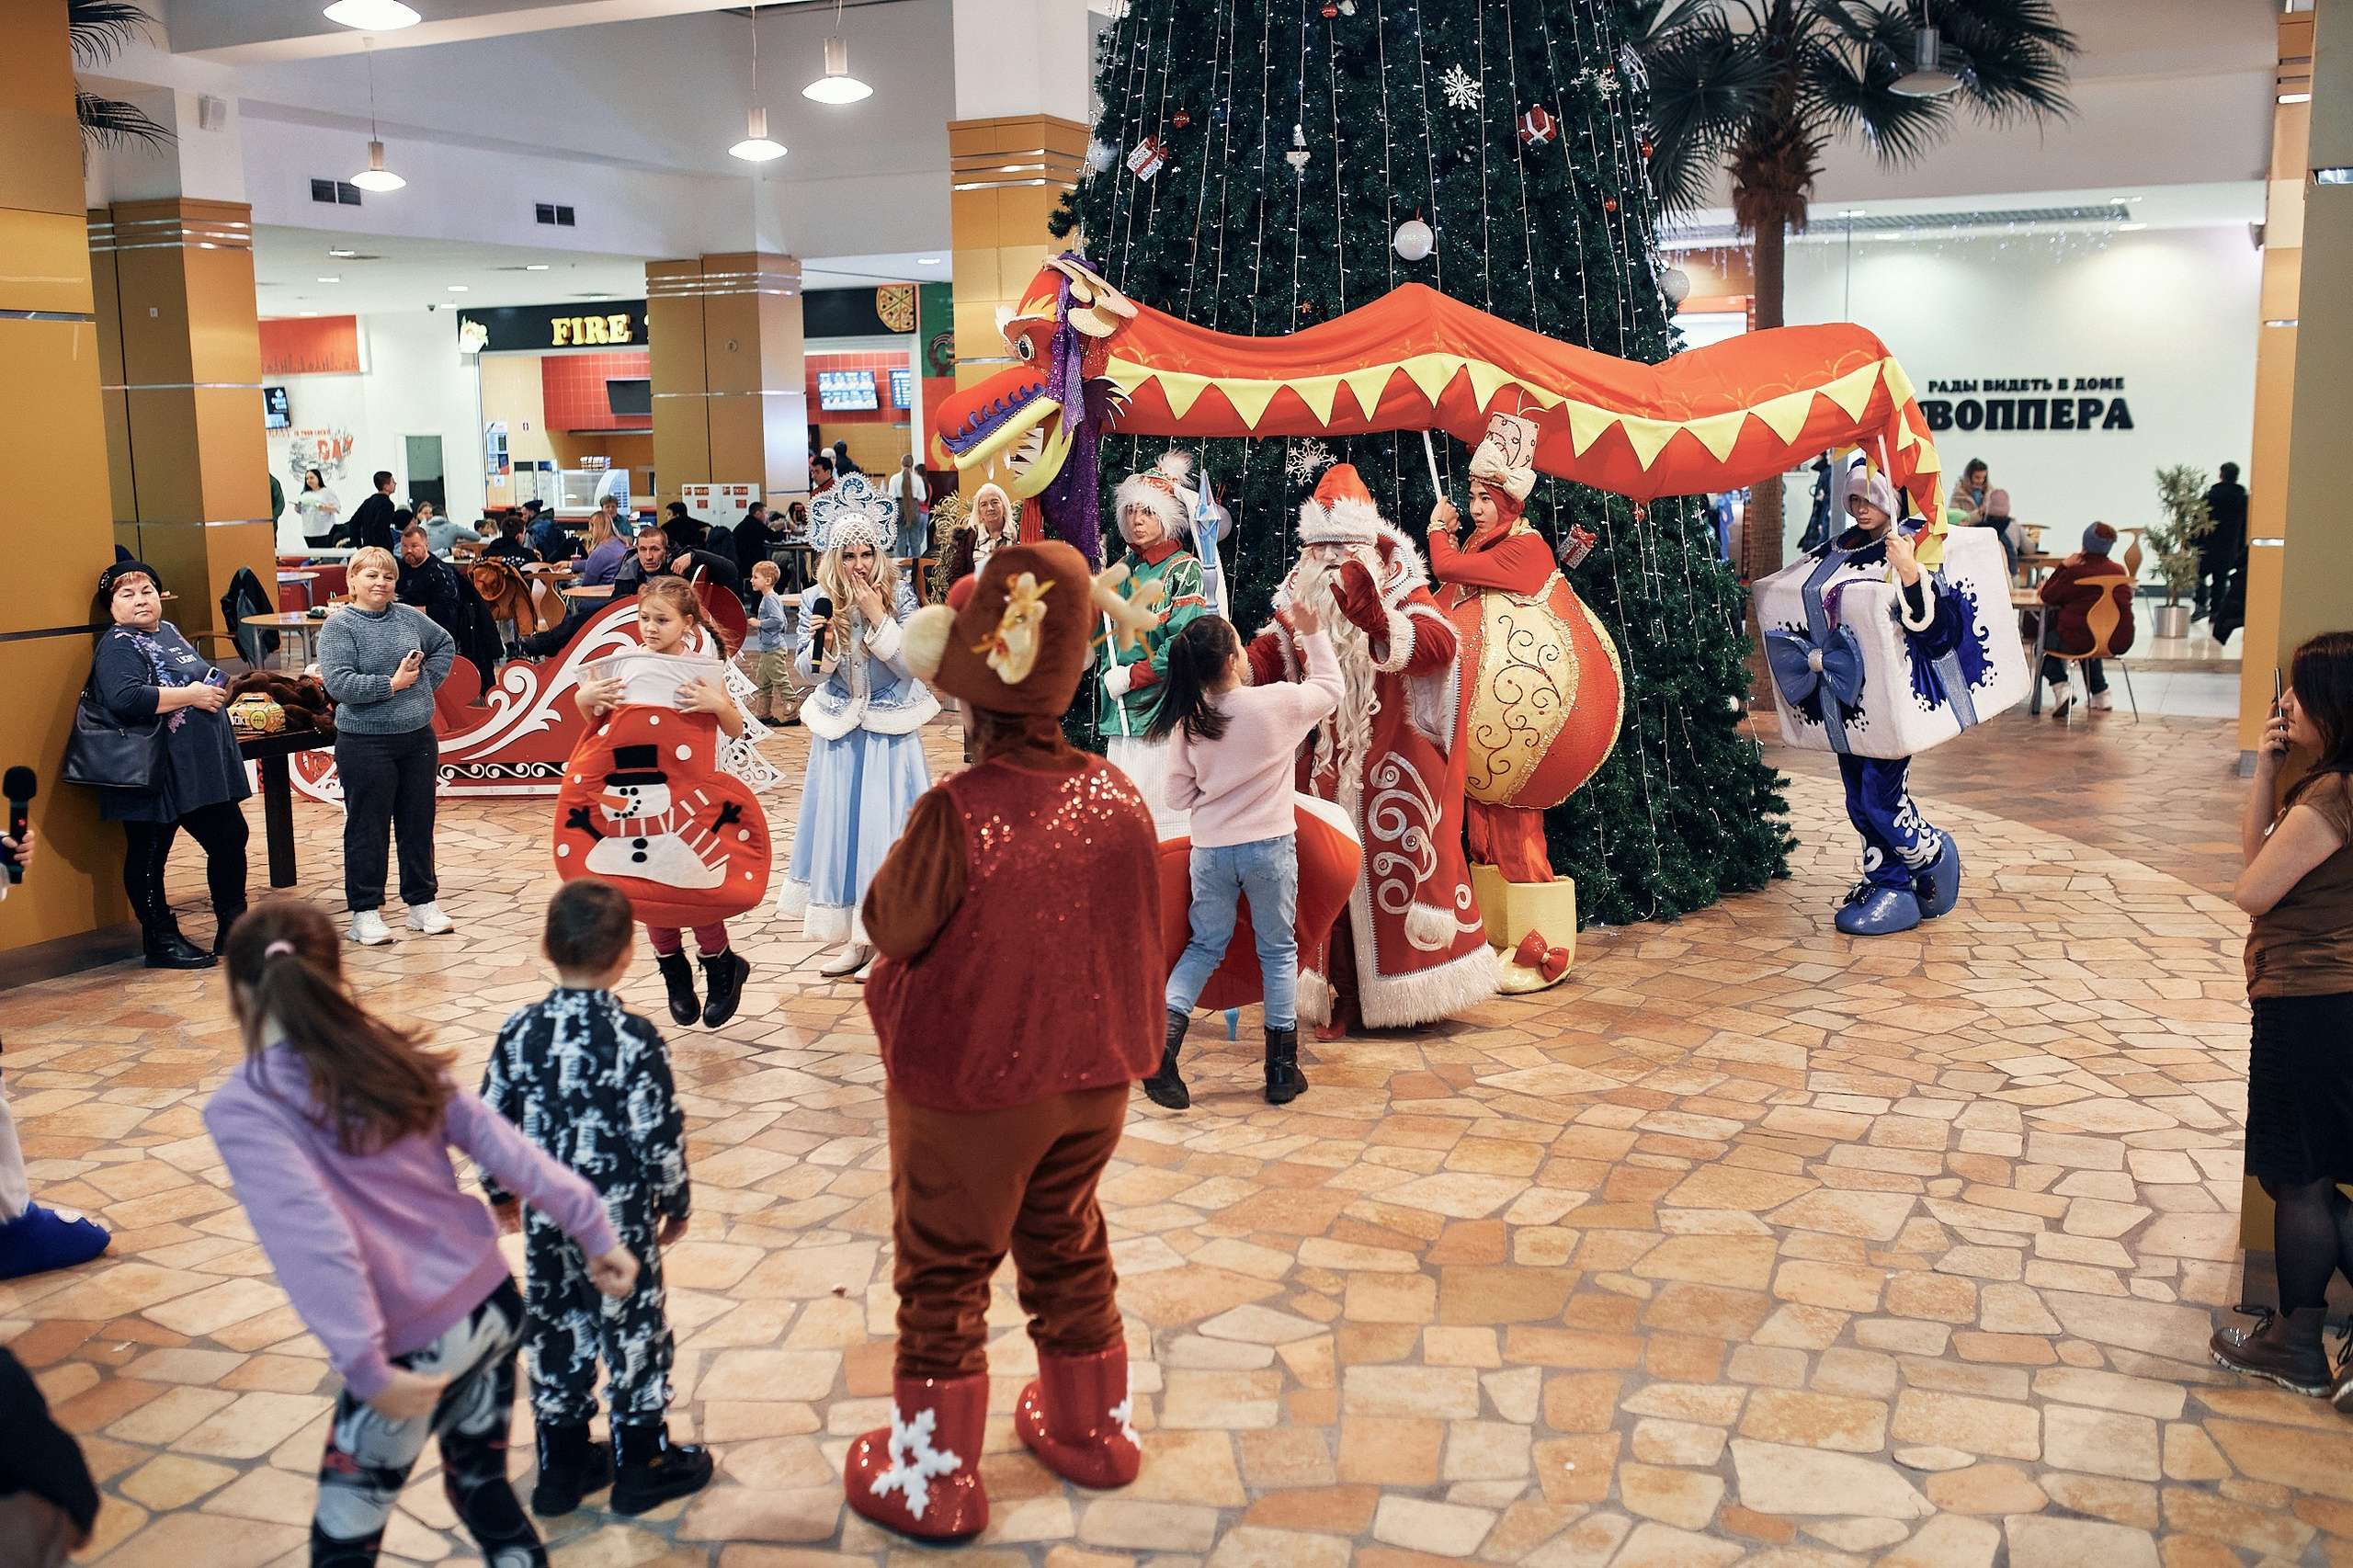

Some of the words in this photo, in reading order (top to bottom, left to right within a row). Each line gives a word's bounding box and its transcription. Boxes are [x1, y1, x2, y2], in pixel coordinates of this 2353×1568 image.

[551, 313, 632, 346] FIRE
[1928, 380, 1978, 392] РАДЫ
[1983, 378, 2052, 392] ВИДЕТЬ
[2058, 379, 2069, 391] В
[2074, 378, 2125, 391] ДОМЕ
[1917, 398, 2134, 431] ВОППЕРА
[317, 437, 354, 461] DAY
